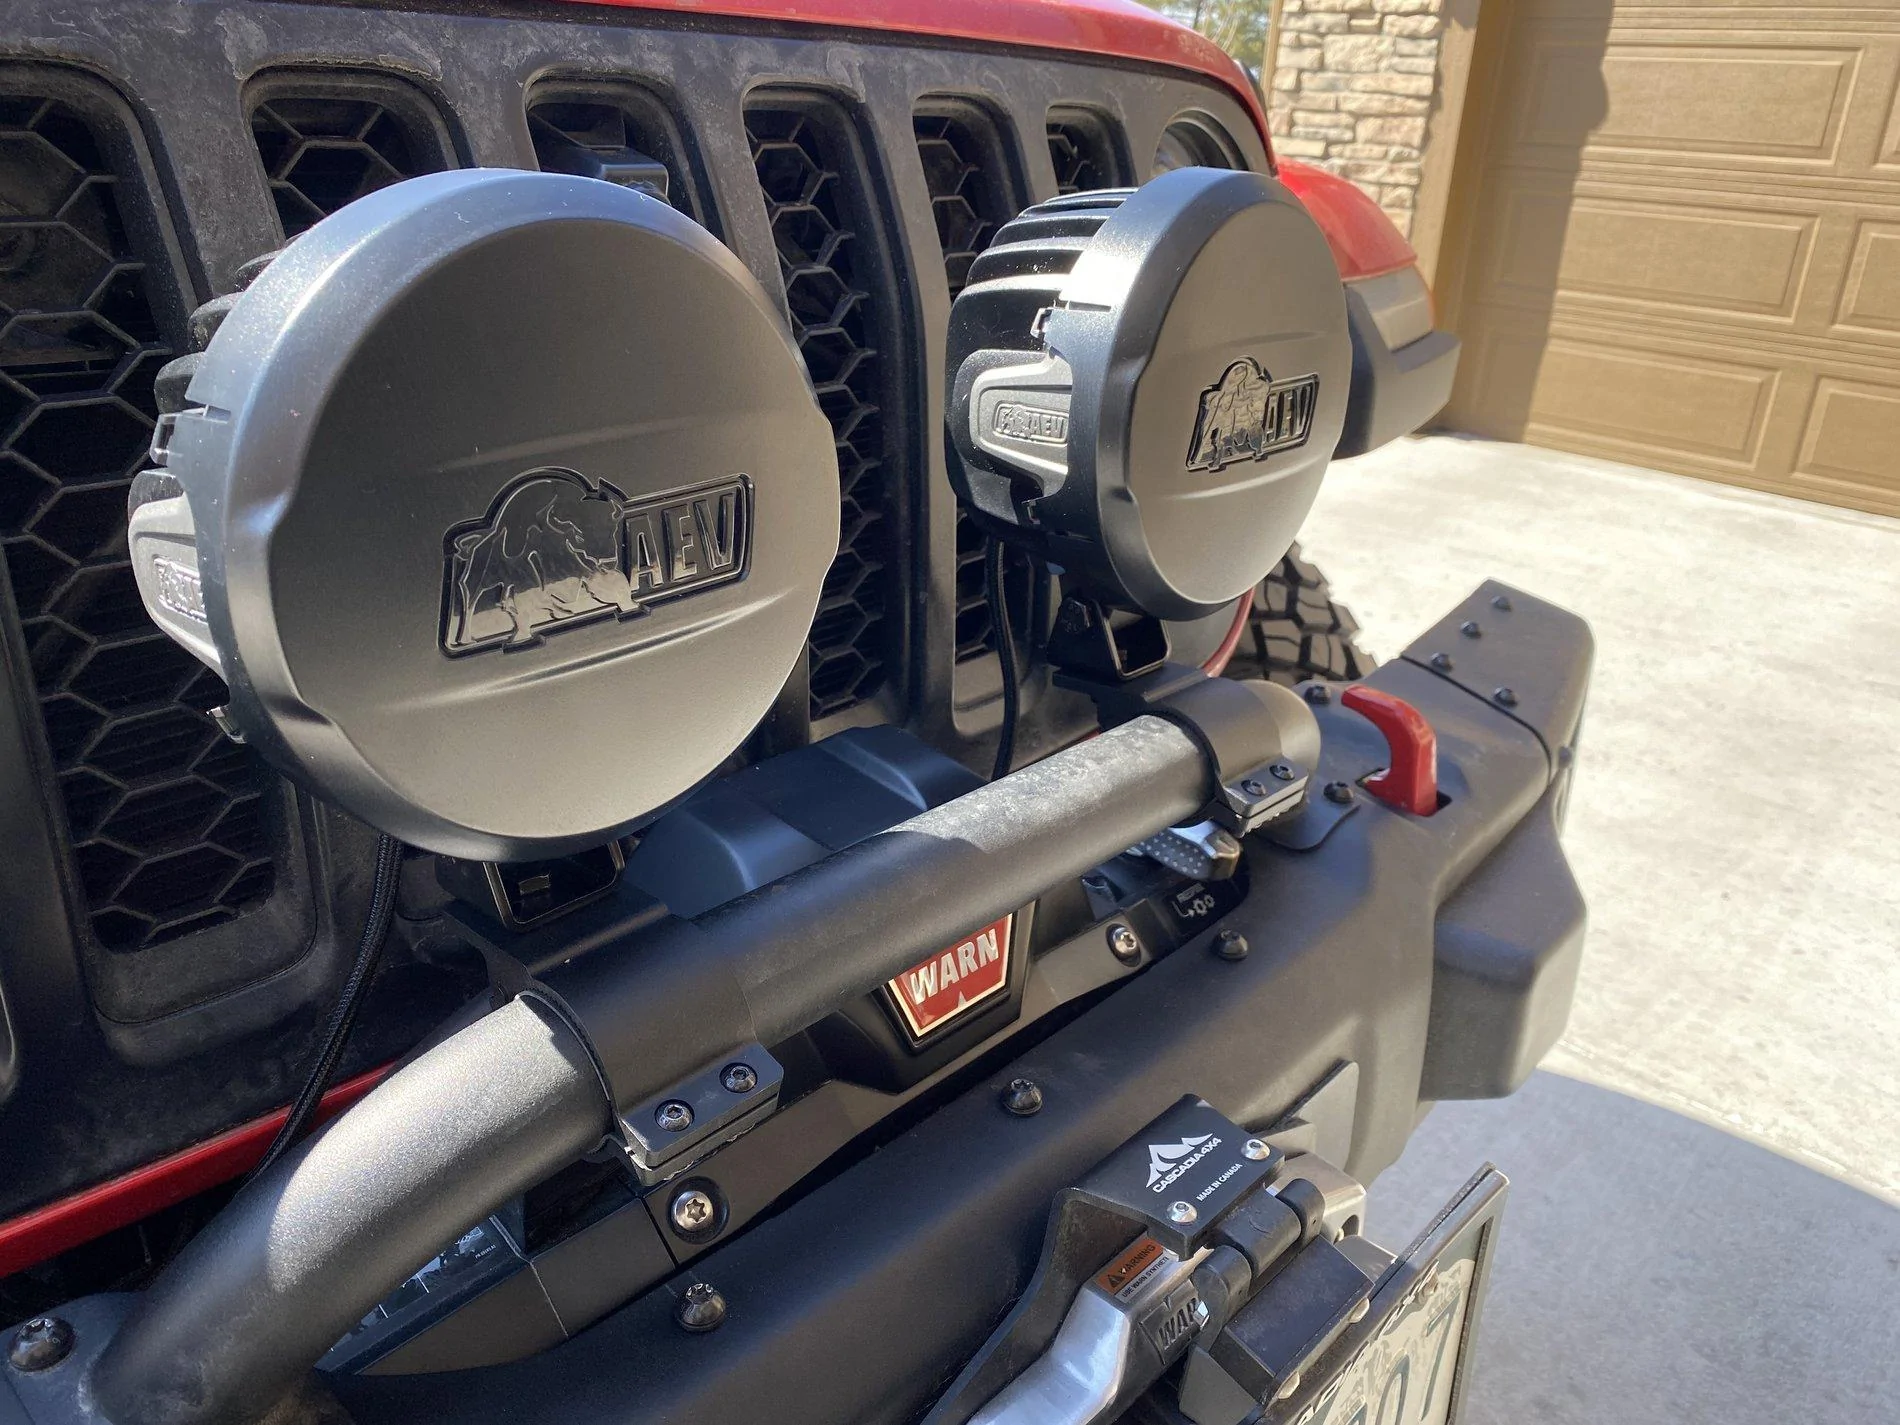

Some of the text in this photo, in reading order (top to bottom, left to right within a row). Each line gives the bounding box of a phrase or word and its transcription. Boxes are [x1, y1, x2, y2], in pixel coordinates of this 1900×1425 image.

[1263, 386, 1312, 446] AEV
[624, 492, 736, 593] AEV
[910, 928, 999, 1005] WARN
[1196, 1185, 1216, 1201] MADE
[1218, 1163, 1243, 1182] CANADA
[1121, 1286, 1135, 1298] USE
[1158, 1297, 1199, 1349] WAR
